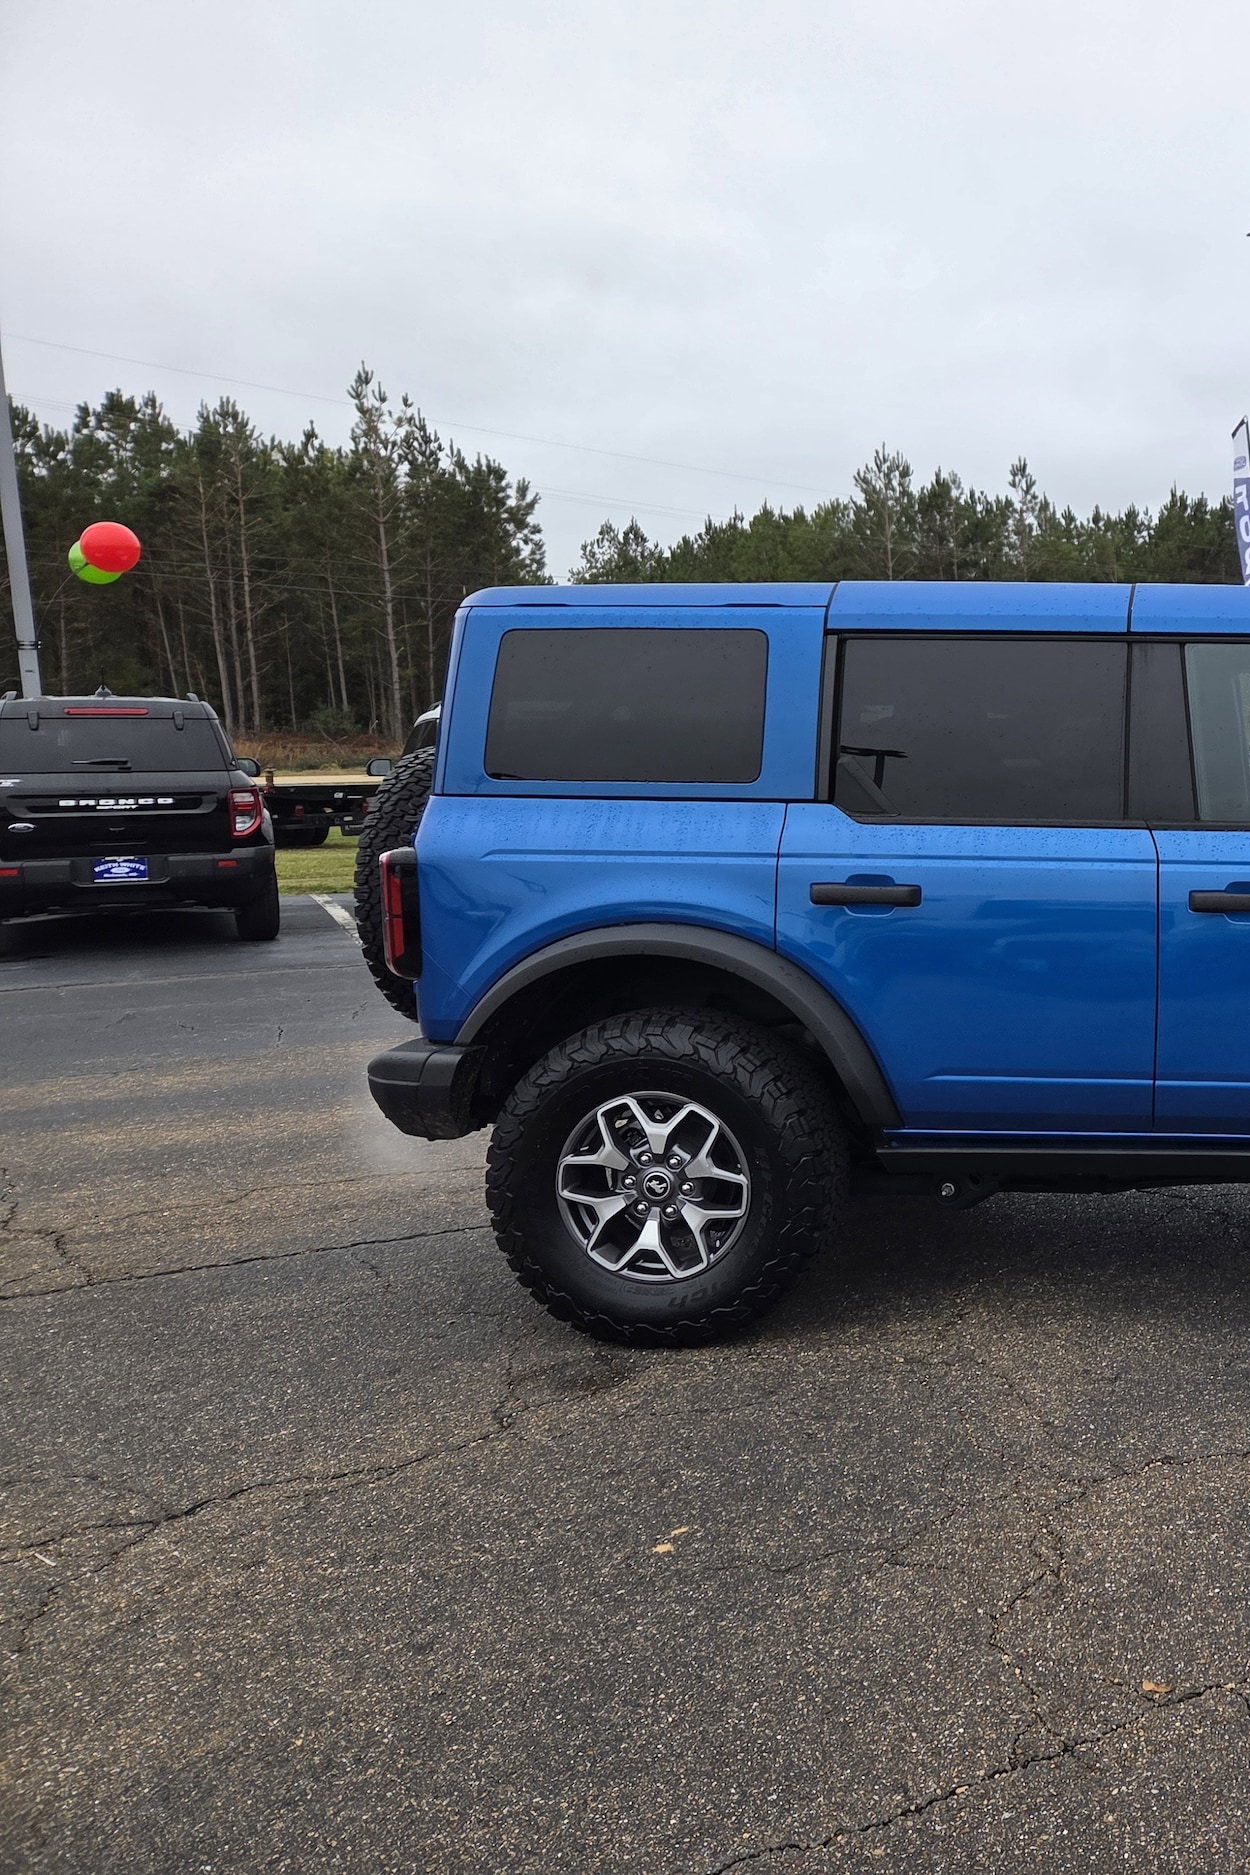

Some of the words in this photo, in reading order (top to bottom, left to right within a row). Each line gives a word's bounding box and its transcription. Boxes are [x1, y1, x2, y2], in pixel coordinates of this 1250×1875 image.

[58, 798, 174, 806] BRONCO
[94, 862, 119, 873] KEITH
[119, 862, 146, 871] WHITE
